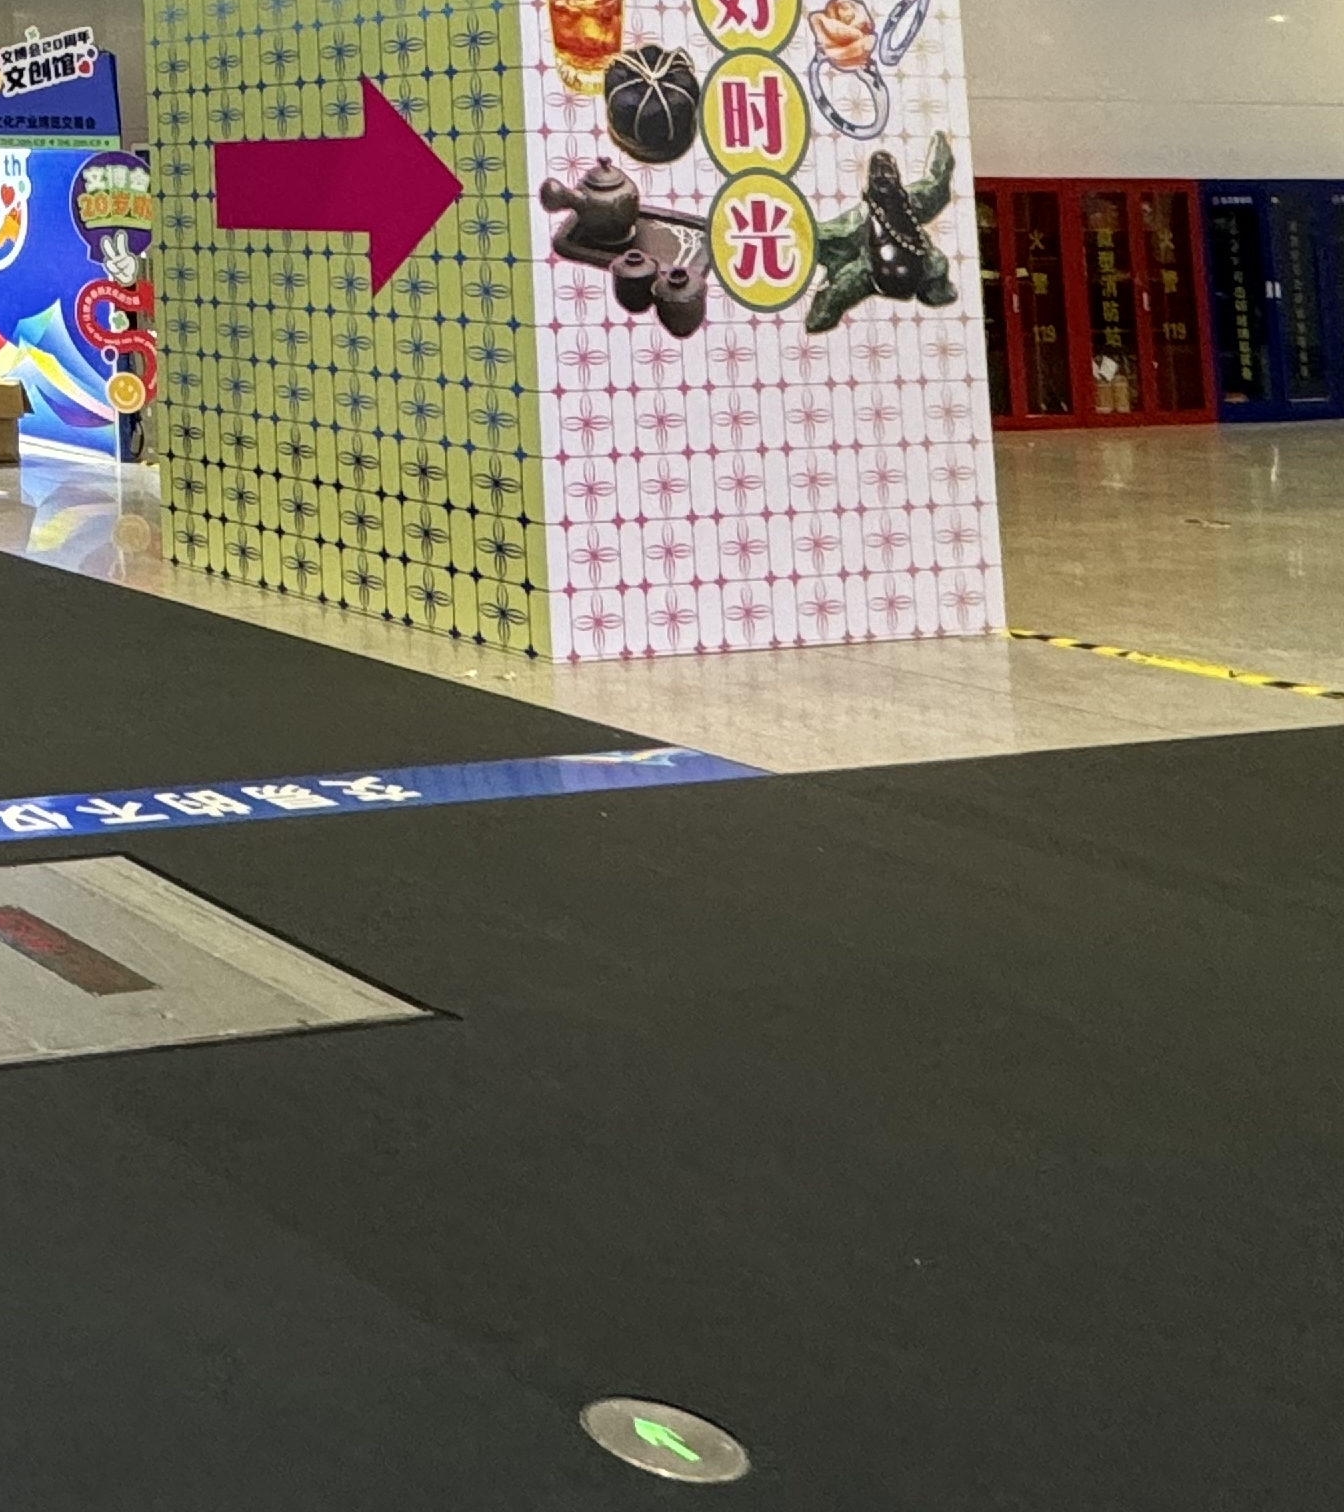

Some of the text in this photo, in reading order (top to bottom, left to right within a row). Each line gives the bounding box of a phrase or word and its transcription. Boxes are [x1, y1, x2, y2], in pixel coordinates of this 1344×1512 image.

[0, 29, 90, 65] 文博会20周年
[4, 52, 76, 93] 文创馆
